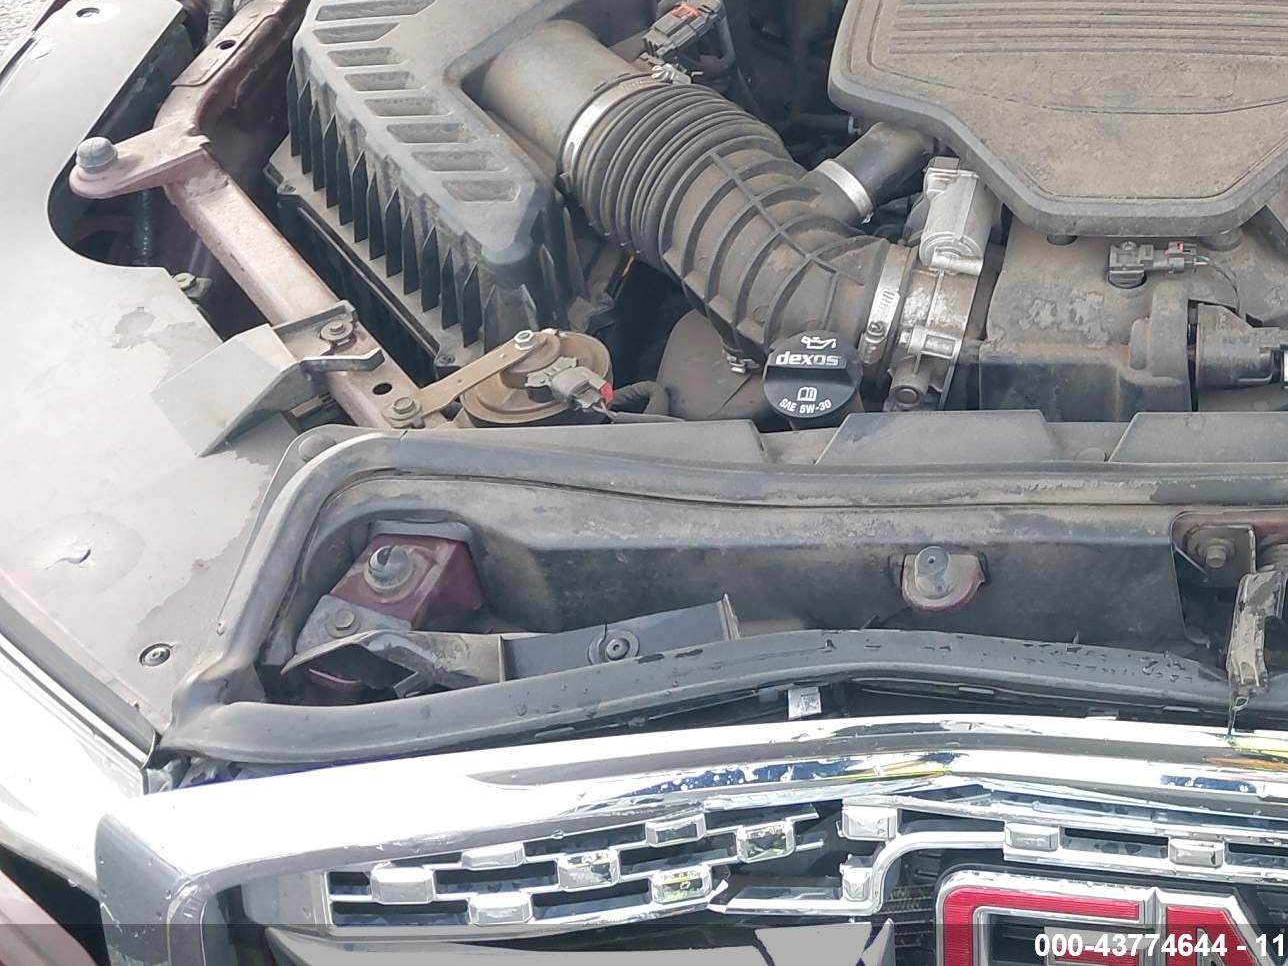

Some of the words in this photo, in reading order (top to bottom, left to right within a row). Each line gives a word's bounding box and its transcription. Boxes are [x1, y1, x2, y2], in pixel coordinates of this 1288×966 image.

[776, 351, 841, 366] dexos
[780, 398, 797, 412] SAE
[800, 399, 832, 414] 5W-30
